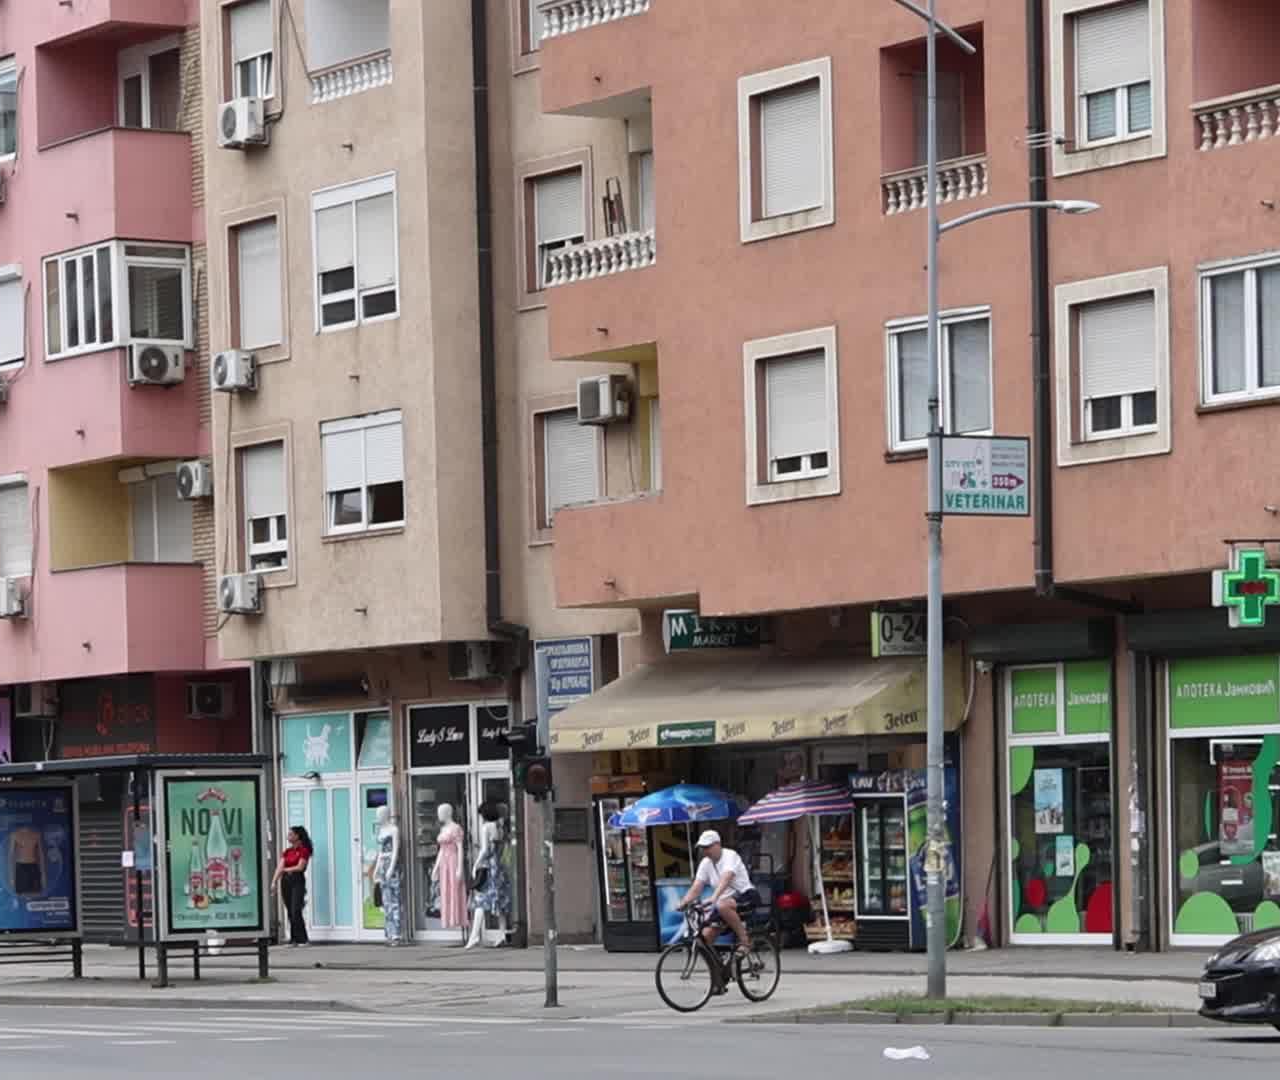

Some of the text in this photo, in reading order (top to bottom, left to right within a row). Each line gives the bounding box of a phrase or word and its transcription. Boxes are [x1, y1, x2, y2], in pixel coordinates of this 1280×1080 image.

[945, 494, 1024, 509] VETERINAR
[692, 633, 737, 647] MARKET
[1176, 680, 1275, 698] АПОТЕКА Јанковић
[1014, 692, 1055, 708] АПОТЕКА
